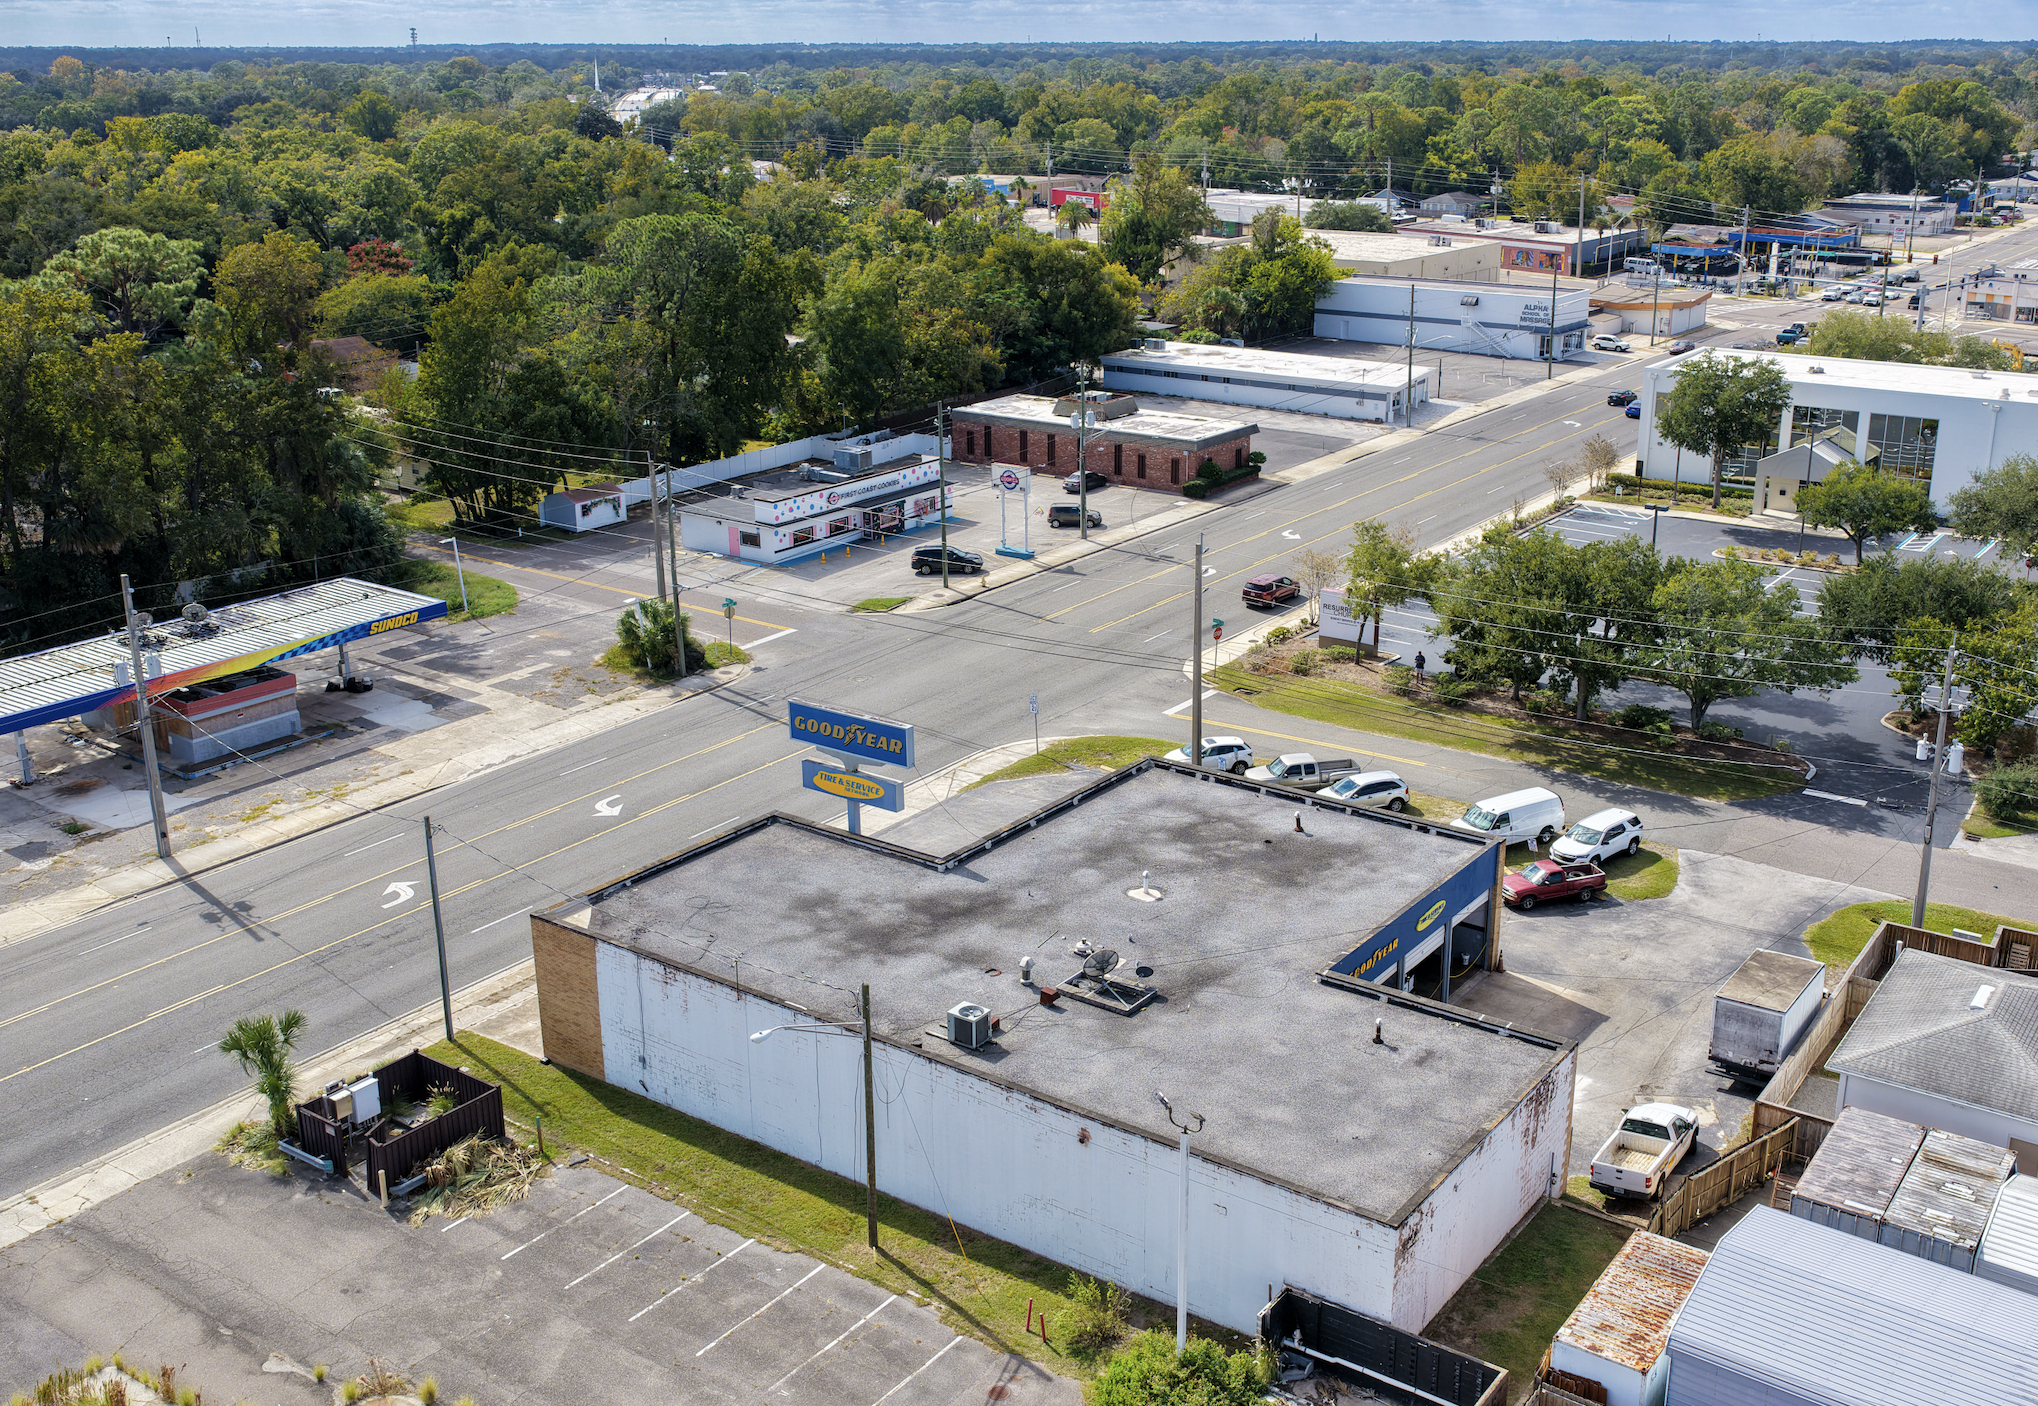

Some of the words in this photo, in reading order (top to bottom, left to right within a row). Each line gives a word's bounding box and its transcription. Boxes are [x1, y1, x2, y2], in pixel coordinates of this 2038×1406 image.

[1523, 304, 1549, 312] ALPHA
[1520, 316, 1551, 324] MASSAGE
[840, 490, 857, 500] FIRST
[857, 484, 877, 495] COAST
[877, 478, 900, 490] COOKIES
[1323, 603, 1353, 613] RESURRE
[370, 611, 419, 635] SUNOCO
[819, 772, 837, 783] TIRE
[838, 777, 845, 786] &
[845, 780, 881, 796] SERVICE
[844, 786, 870, 797] NETWORK
